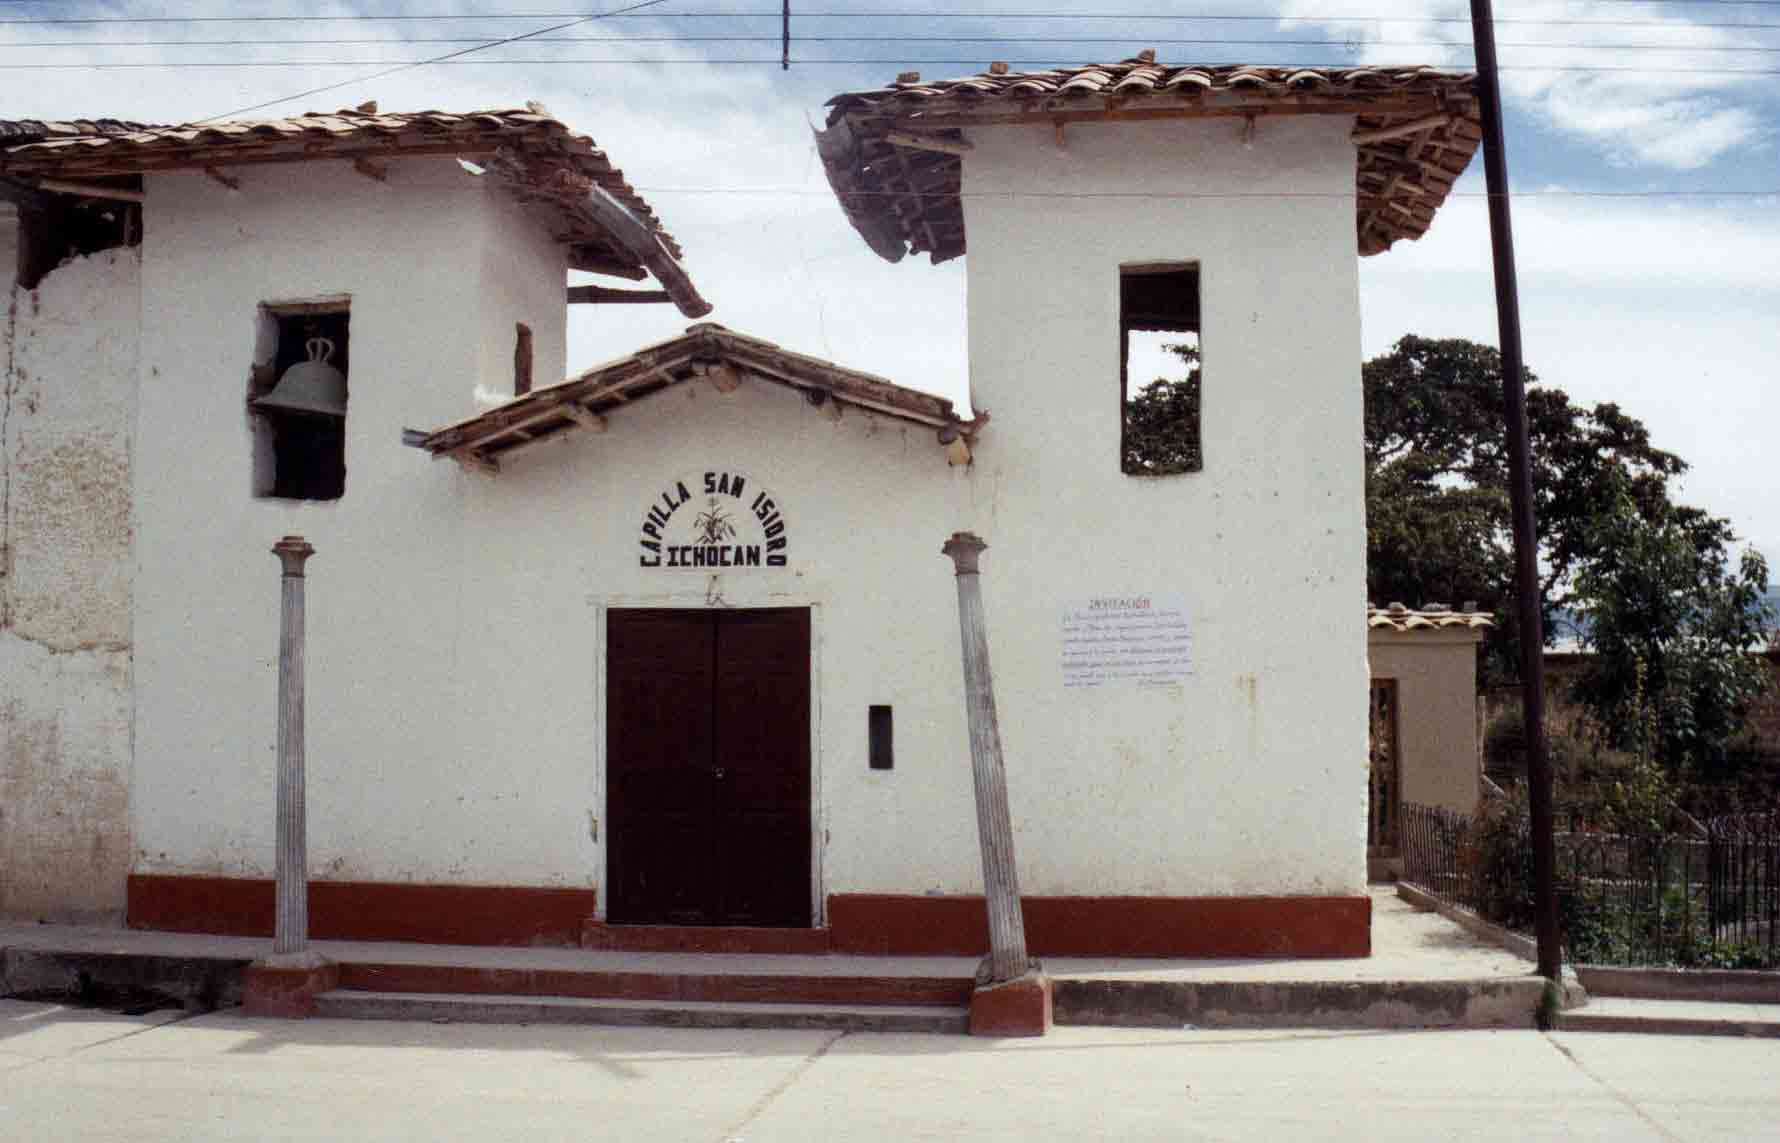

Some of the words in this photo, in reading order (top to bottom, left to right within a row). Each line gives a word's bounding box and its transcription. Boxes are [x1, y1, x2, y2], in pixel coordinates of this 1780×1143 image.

[640, 481, 692, 567] CAPILLA
[704, 471, 745, 498] SAN
[752, 491, 787, 567] ISIDRO
[667, 545, 760, 567] ICHOCAN
